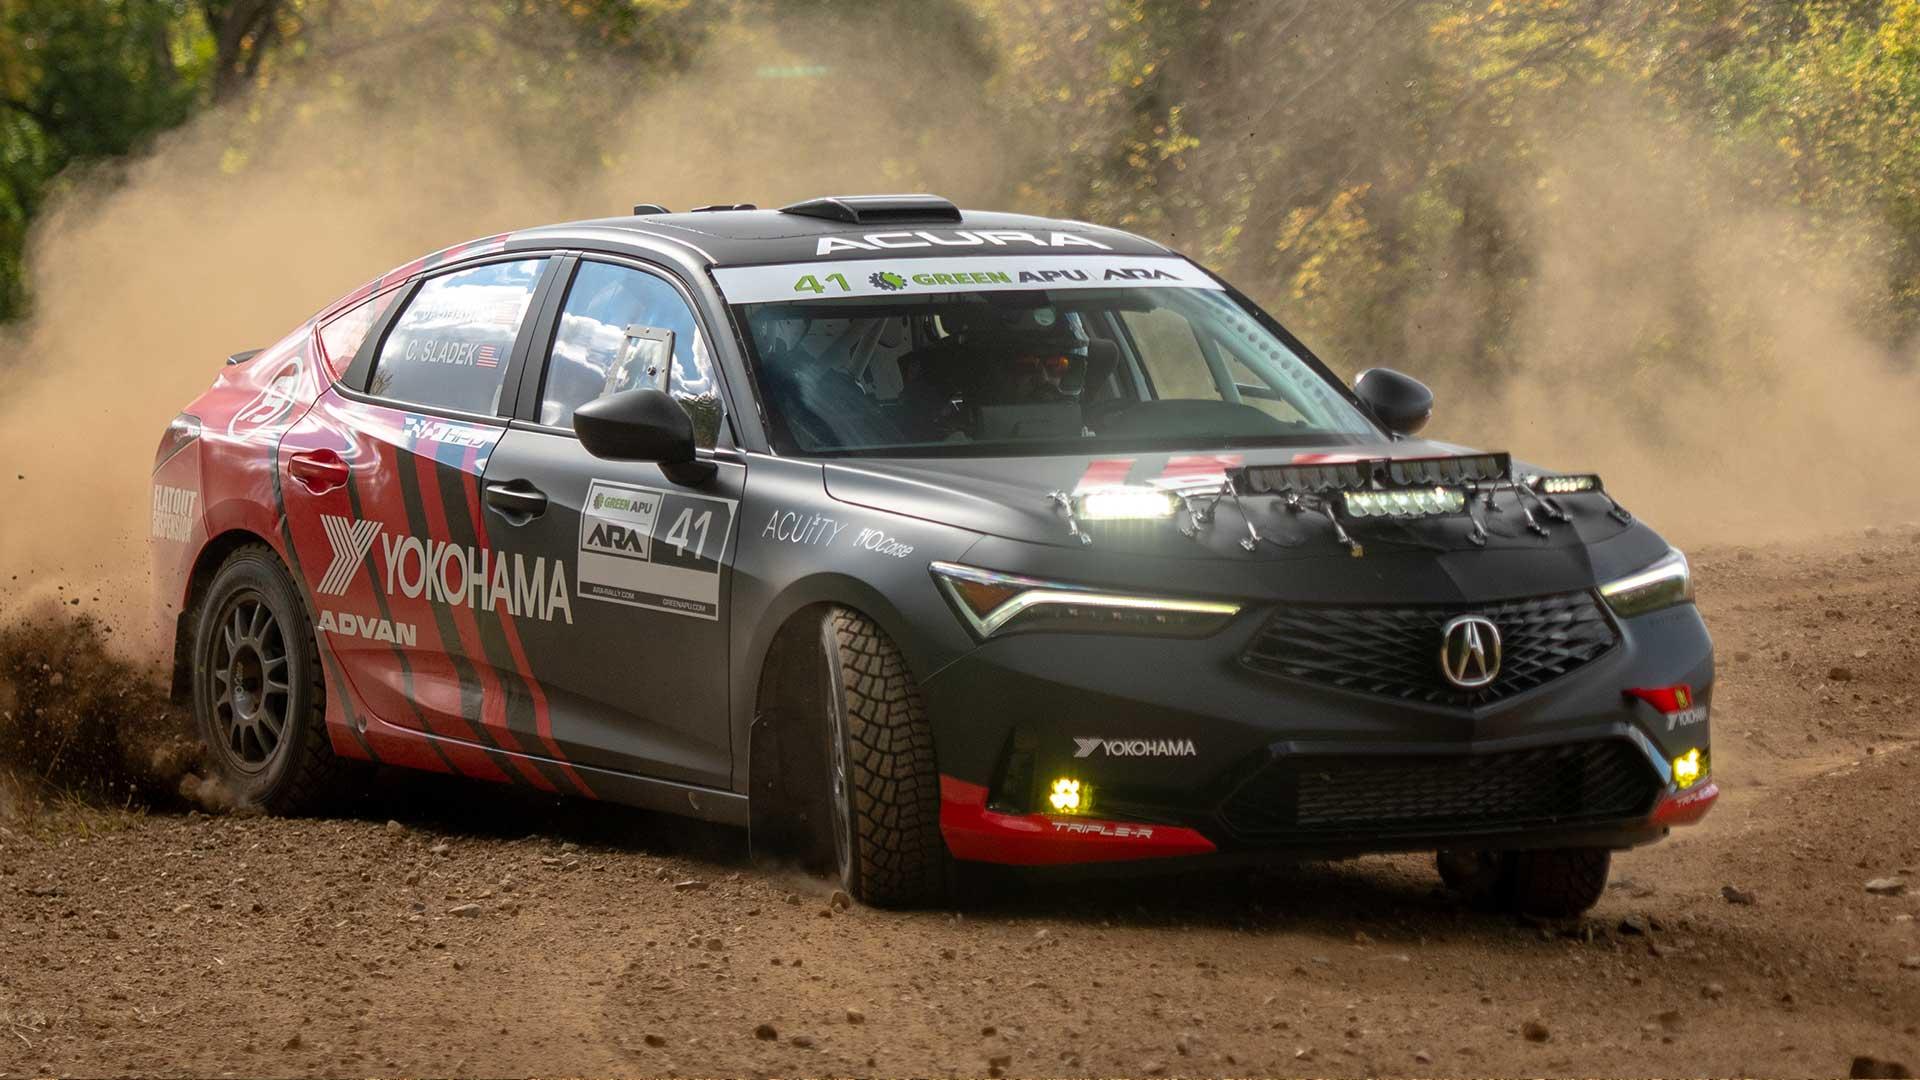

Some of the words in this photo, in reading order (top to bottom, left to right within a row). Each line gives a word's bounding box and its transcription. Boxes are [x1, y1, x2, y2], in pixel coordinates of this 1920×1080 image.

[816, 231, 1113, 256] ACURA
[793, 272, 852, 294] 41
[911, 271, 1012, 286] GREEN
[1018, 269, 1086, 284] APU
[1103, 268, 1185, 281] ARA
[405, 339, 418, 361] C.
[421, 340, 480, 366] SLADEK
[603, 496, 631, 511] GREEN
[630, 500, 652, 514] APU
[586, 523, 643, 553] ARA
[665, 507, 713, 560] 41
[381, 532, 574, 625] YOKOHAMA
[592, 586, 635, 600] ARA-RALLY.COM
[662, 598, 706, 612] GREENAPU.COM
[318, 610, 416, 647] ADVAN
[1103, 739, 1197, 756] YOKOHAMA
[1052, 822, 1153, 839] TRIPLE-R
